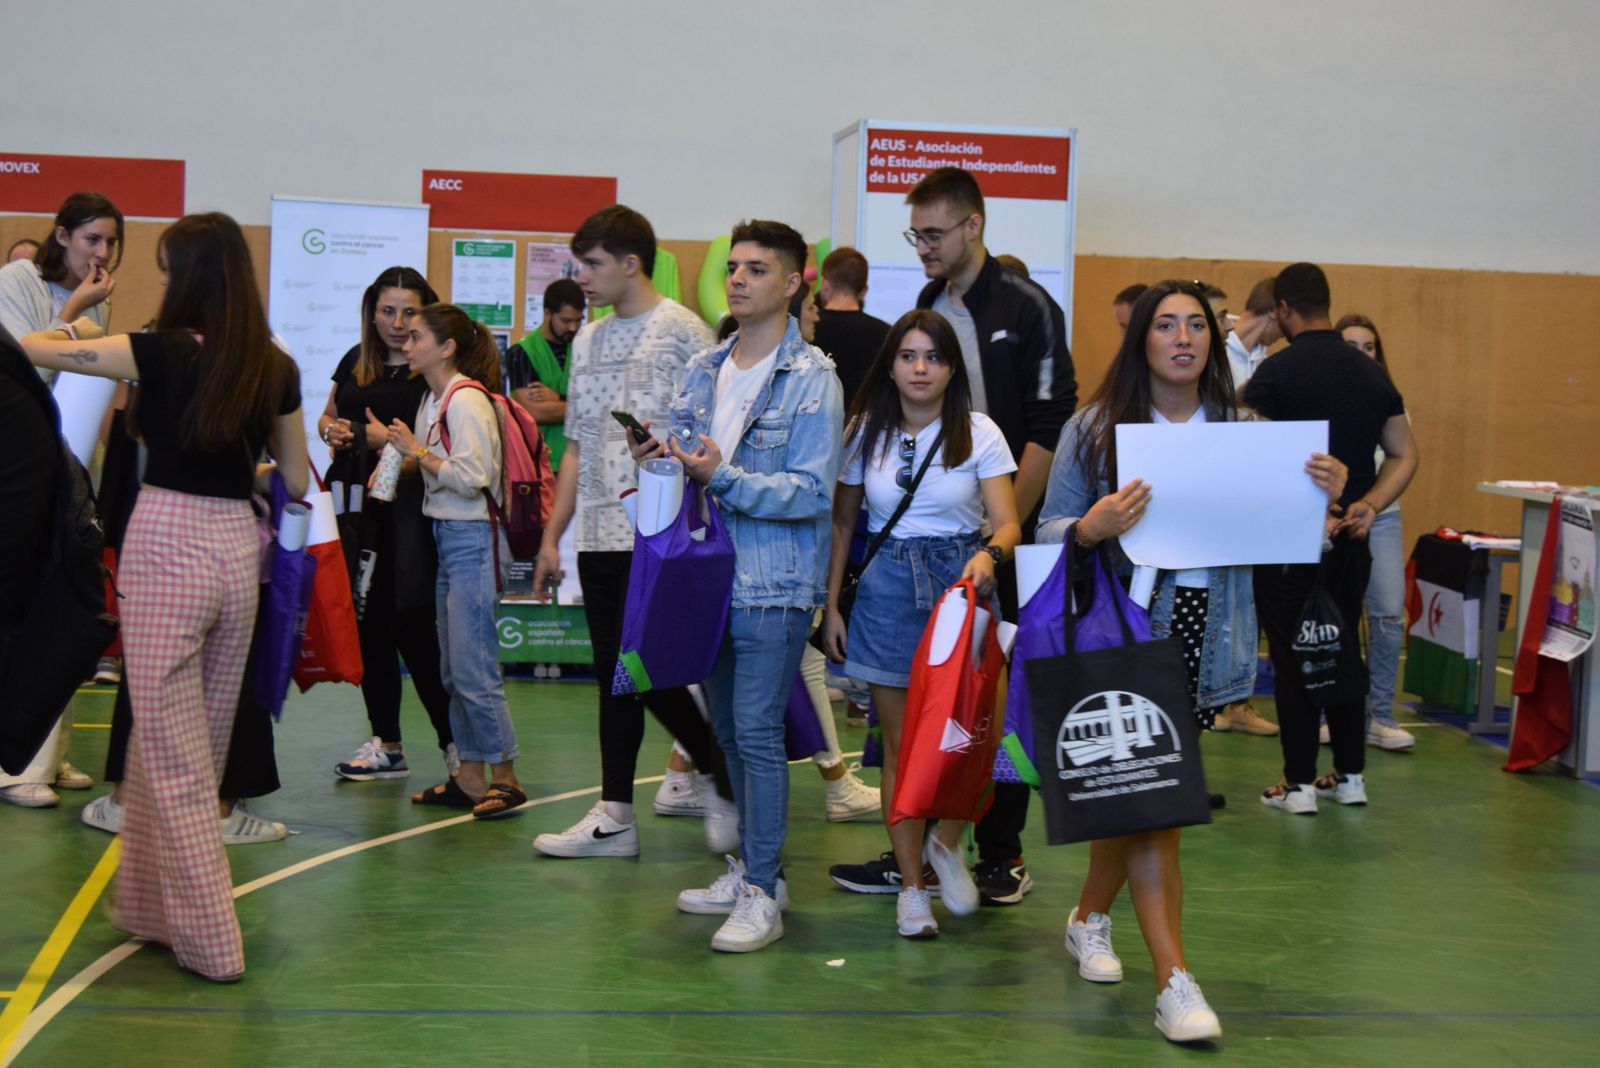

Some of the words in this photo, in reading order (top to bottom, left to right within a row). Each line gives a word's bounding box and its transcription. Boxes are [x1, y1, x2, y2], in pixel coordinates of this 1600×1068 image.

[870, 138, 906, 151] AEUS
[915, 140, 983, 155] Asociación
[869, 154, 886, 167] de
[887, 155, 960, 169] Estudiantes
[962, 158, 1057, 174] Independientes
[429, 178, 463, 191] AECC
[869, 171, 885, 183] de
[887, 171, 899, 183] la
